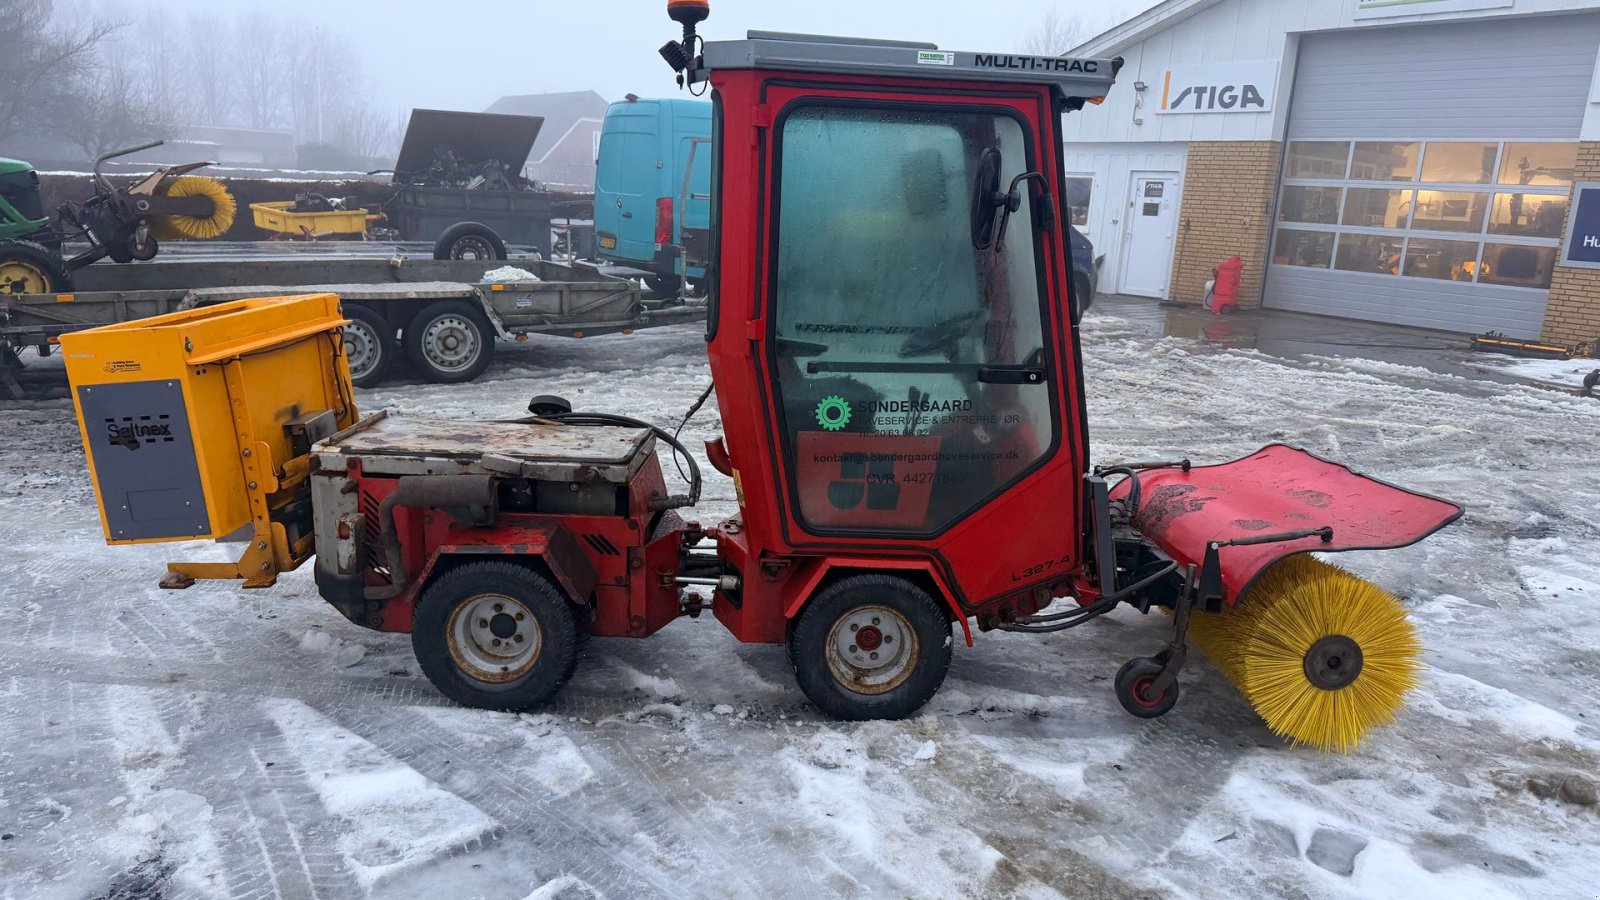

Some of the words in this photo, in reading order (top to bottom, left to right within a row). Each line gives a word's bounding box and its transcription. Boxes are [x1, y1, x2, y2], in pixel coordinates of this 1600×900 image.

[974, 54, 1098, 73] MULTI-TRAC
[1170, 84, 1265, 110] STIGA
[858, 399, 973, 413] SØNDERGAARD
[931, 415, 939, 425] &
[942, 414, 1021, 425] ENTREPREØR
